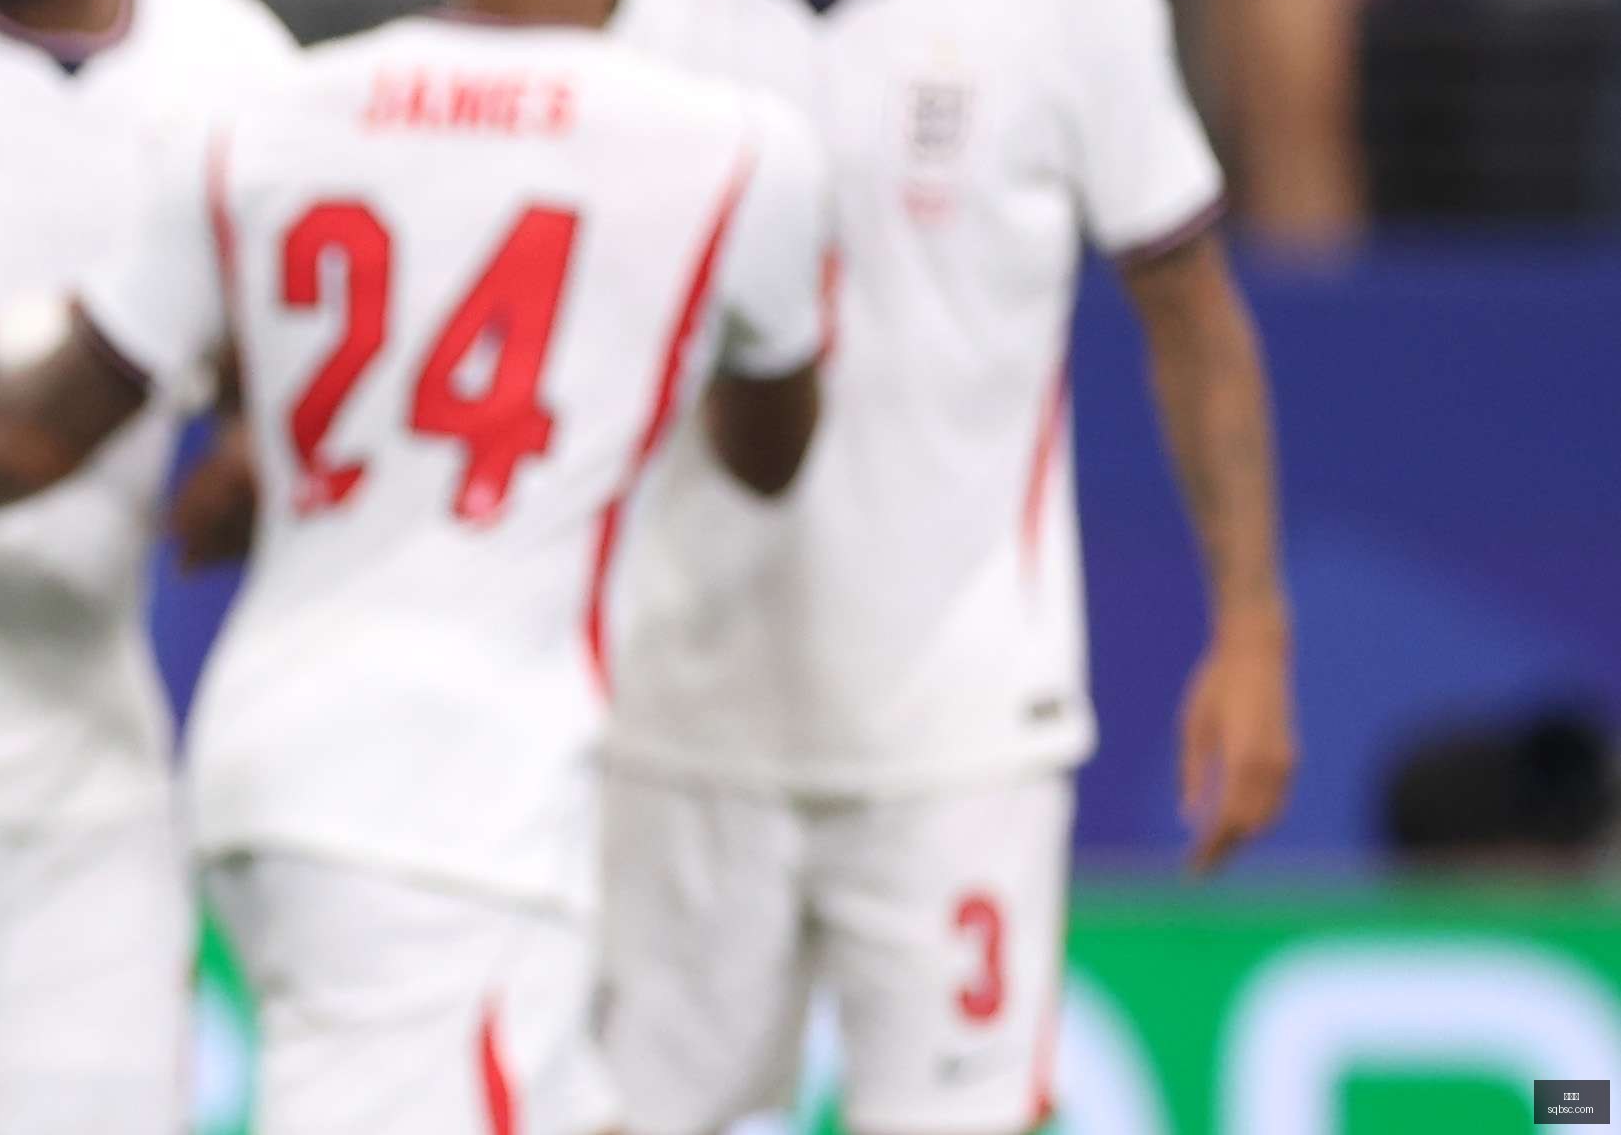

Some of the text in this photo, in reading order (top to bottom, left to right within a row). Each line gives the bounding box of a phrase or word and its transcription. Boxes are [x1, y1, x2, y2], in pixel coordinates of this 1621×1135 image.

[359, 72, 576, 134] JAMES
[282, 201, 580, 526] 24
[953, 895, 1008, 1023] 3
